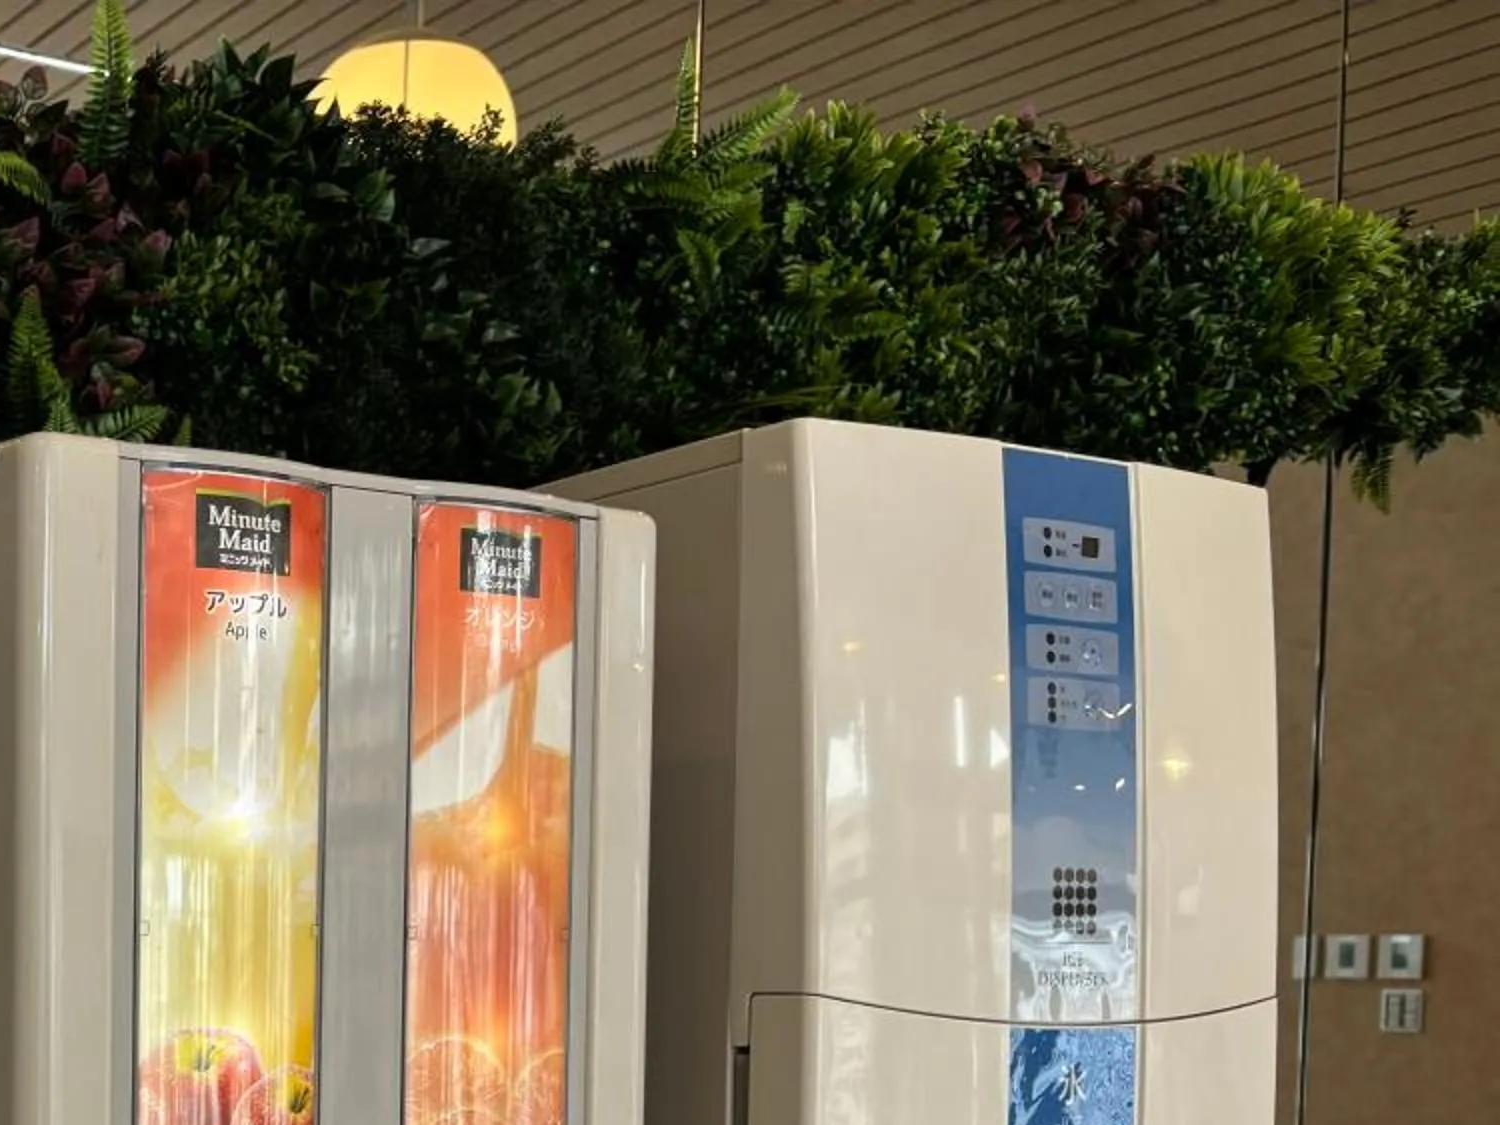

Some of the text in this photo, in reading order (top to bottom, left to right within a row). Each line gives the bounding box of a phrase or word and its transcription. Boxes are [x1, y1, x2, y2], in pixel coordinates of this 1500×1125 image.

[208, 504, 282, 533] Minute
[218, 529, 271, 553] Maid
[472, 537, 533, 563] Minute
[206, 591, 287, 617] アップル
[225, 621, 268, 640] Aple
[1059, 1061, 1088, 1106] 氷
